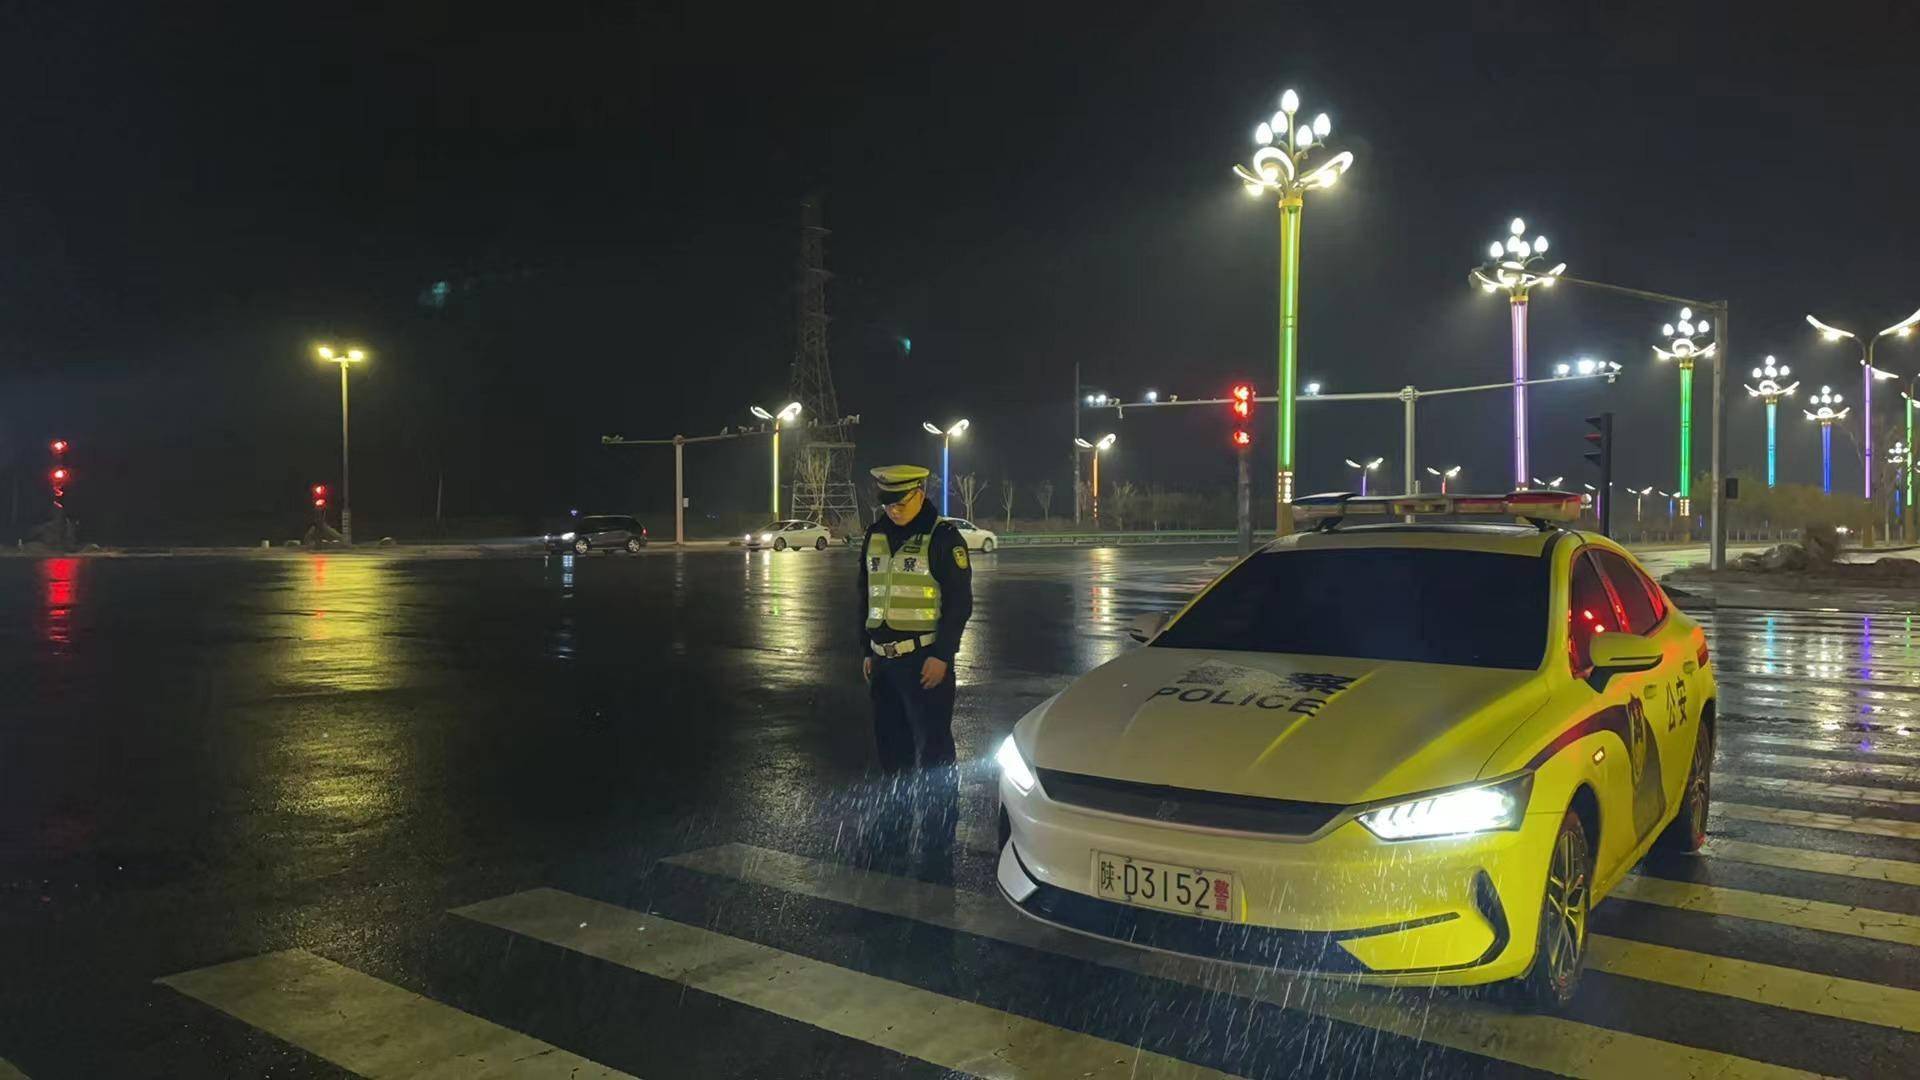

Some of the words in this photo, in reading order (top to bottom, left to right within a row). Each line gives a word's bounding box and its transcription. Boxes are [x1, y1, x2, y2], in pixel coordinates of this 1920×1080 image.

[871, 556, 917, 572] 警察
[1145, 687, 1327, 717] POLICE
[1666, 676, 1687, 732] 公安
